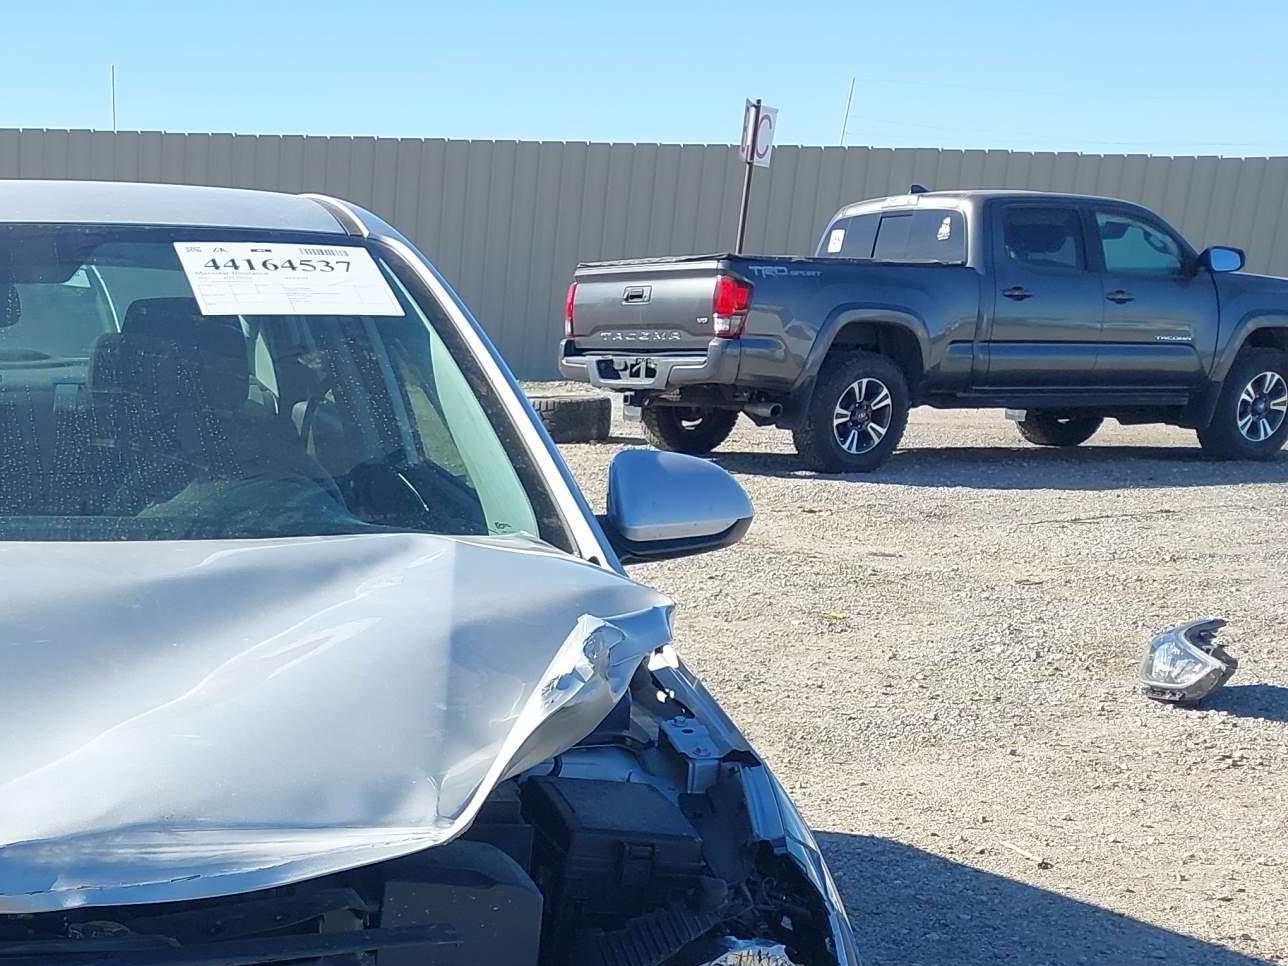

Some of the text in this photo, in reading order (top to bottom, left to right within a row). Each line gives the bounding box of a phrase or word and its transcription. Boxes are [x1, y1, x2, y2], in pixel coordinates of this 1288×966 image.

[204, 258, 351, 272] 44164537
[748, 265, 788, 278] TRD
[600, 331, 681, 341] TACOMA
